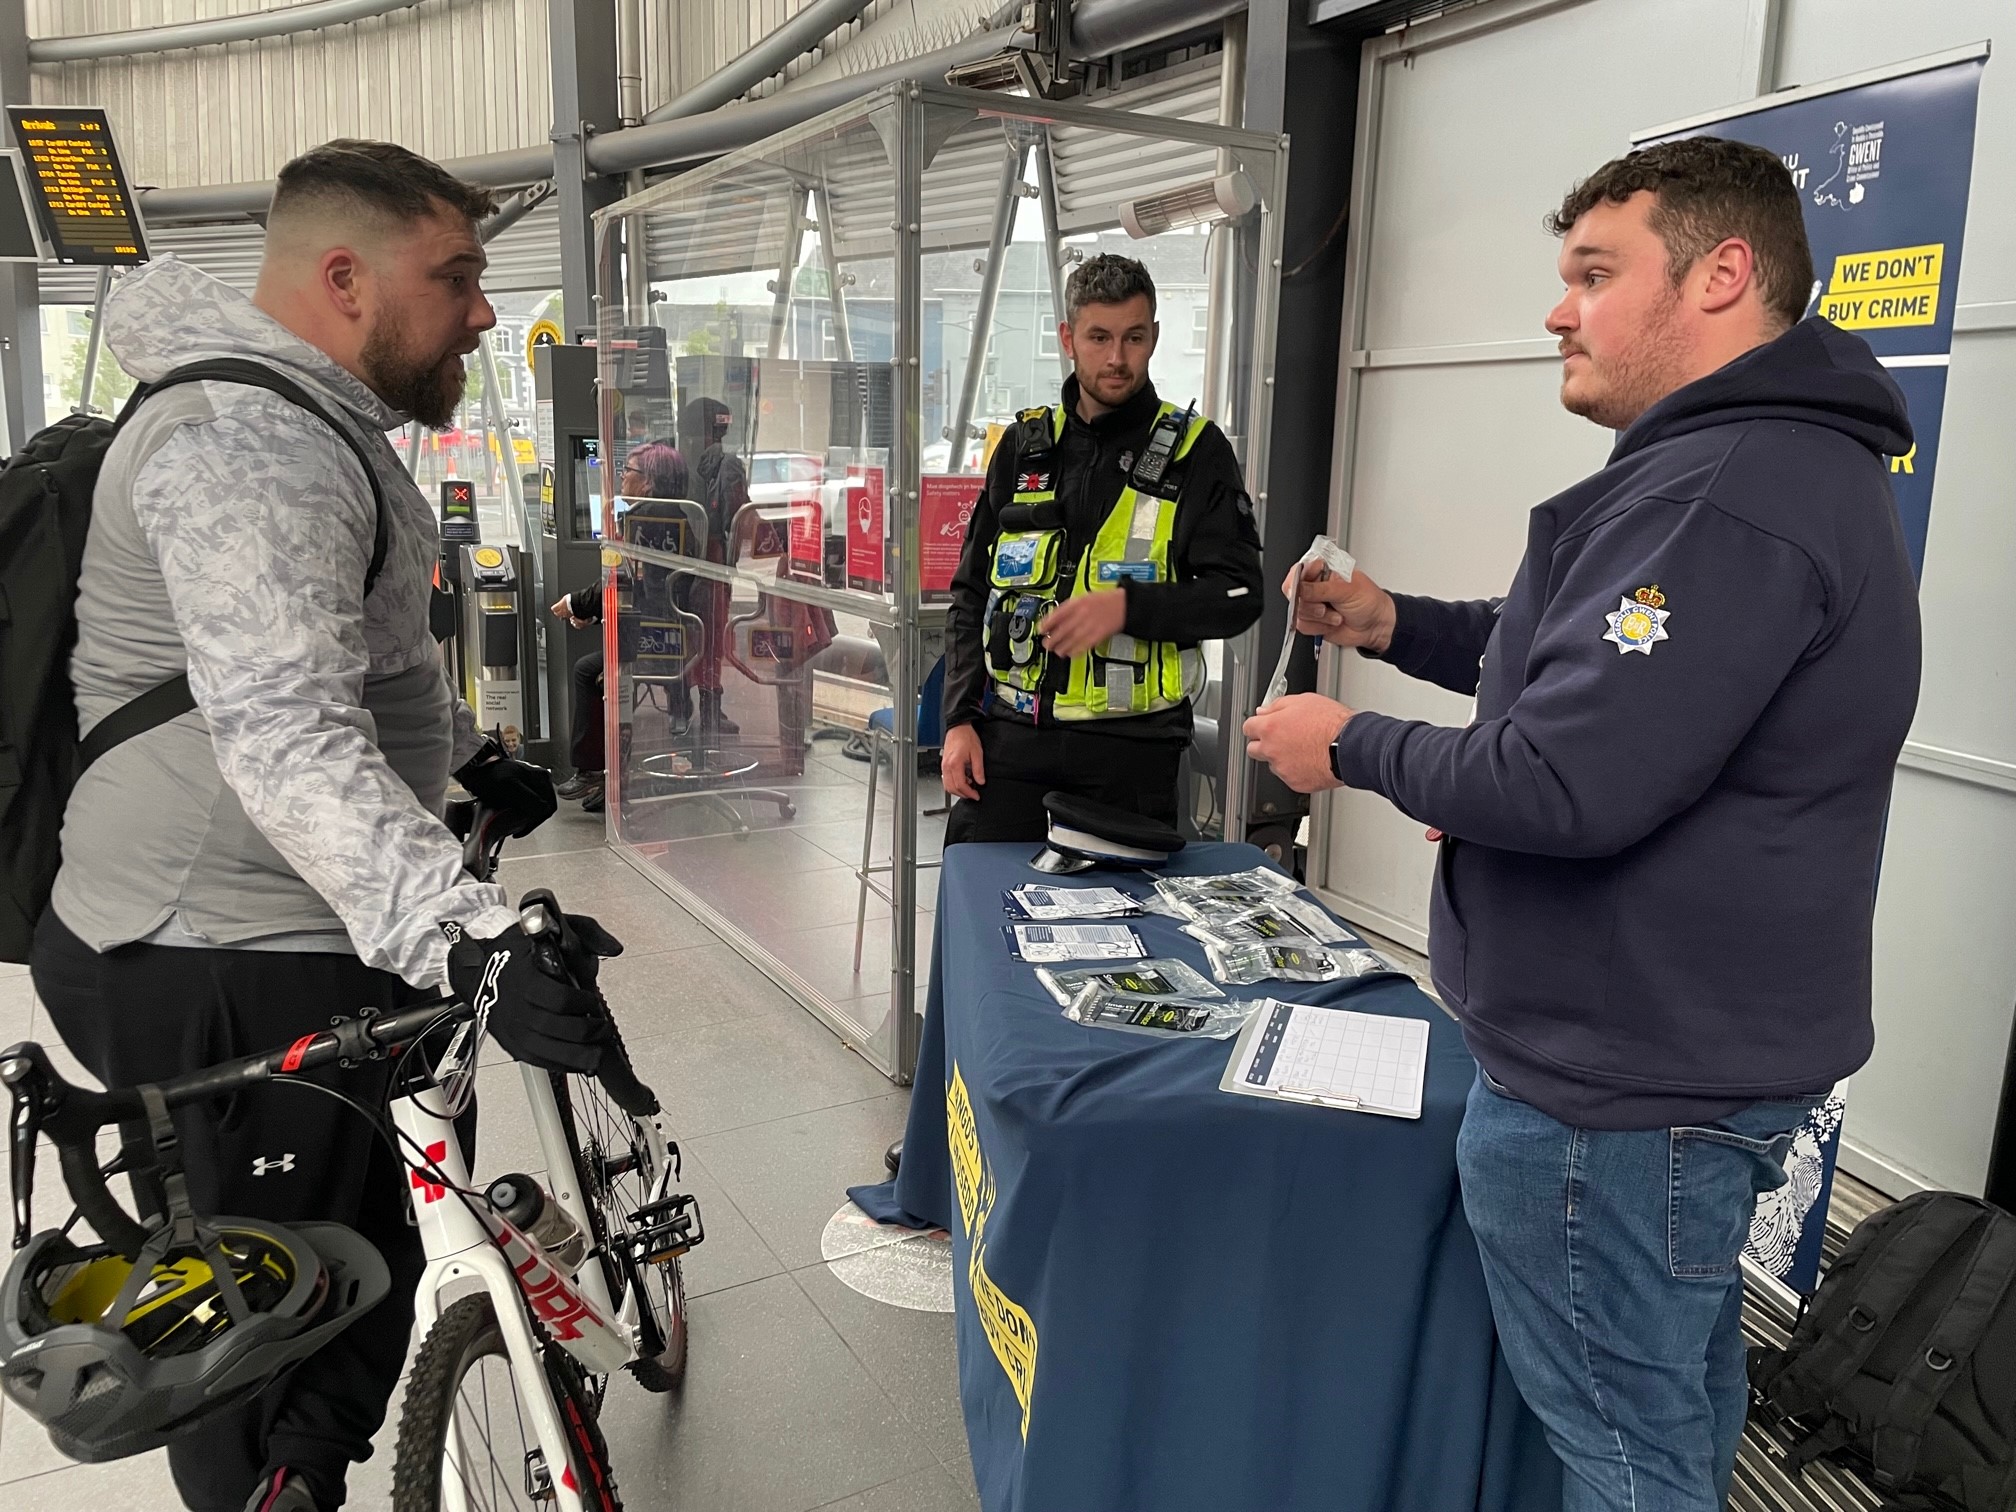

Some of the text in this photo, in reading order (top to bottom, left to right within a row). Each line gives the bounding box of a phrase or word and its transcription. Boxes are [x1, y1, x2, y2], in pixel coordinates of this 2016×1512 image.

[1849, 139, 1882, 166] GWENT
[1843, 254, 1935, 284] WE DON'T
[1828, 295, 1930, 321] BUY CRIME
[1632, 606, 1657, 623] GWENT
[1637, 623, 1658, 645] POLICE
